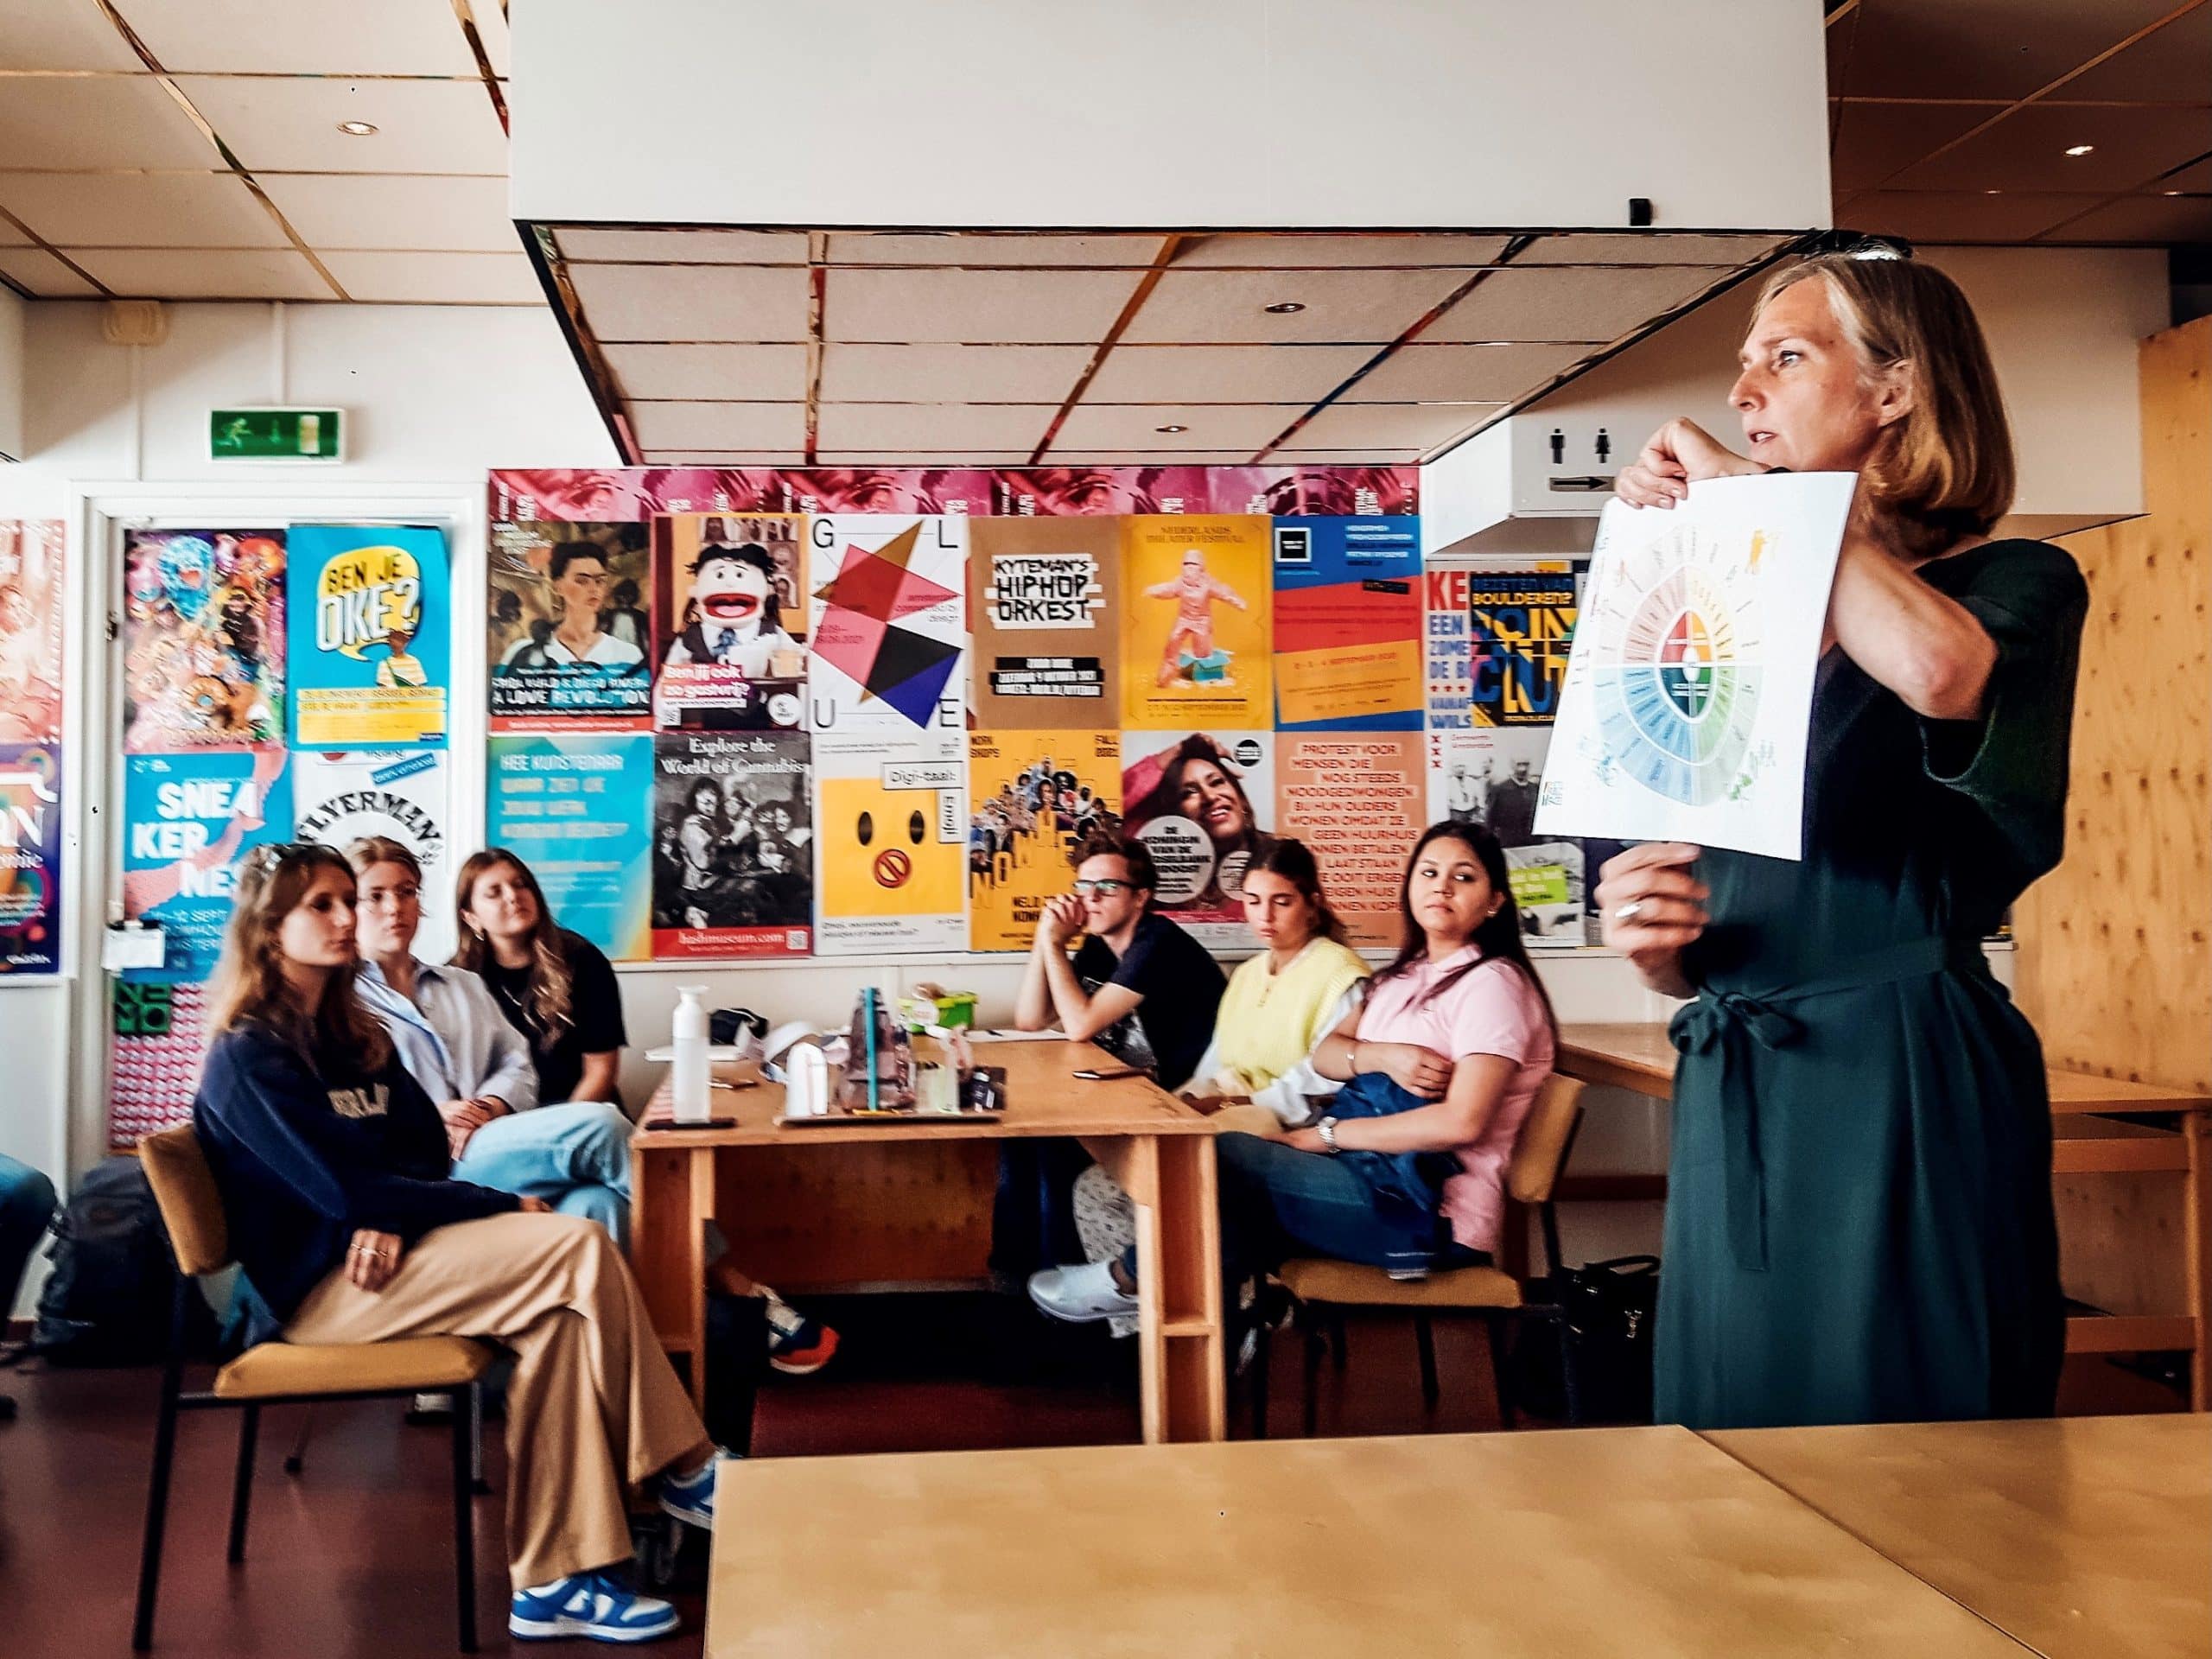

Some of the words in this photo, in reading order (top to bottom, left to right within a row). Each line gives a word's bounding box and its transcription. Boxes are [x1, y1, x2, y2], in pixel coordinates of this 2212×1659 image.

[813, 518, 836, 549] G
[938, 518, 959, 548] L
[327, 562, 367, 592] BEN
[378, 553, 404, 582] JE
[996, 575, 1088, 599] HIPHOP
[316, 576, 420, 651] OKE?
[997, 600, 1090, 622] ORKEST
[1429, 614, 1463, 636] EEN
[710, 664, 742, 679] ook
[492, 690, 505, 704] A
[505, 690, 550, 704] LOVE
[814, 698, 836, 728] U
[939, 698, 960, 728] E
[689, 736, 748, 758] Explore
[749, 736, 776, 753] the
[1302, 745, 1361, 754] PROTEST
[1363, 745, 1396, 754] VOOR
[660, 758, 711, 774] World
[711, 758, 732, 773] of
[732, 757, 804, 774] Cannabis
[1293, 759, 1346, 768] MENSEN
[1349, 759, 1371, 768] DIE
[1322, 773, 1351, 783] NOG
[1352, 773, 1401, 783] STEEDS
[156, 778, 258, 819] SNEA
[1287, 787, 1414, 798] NOODGEDWONGEN
[1345, 802, 1397, 811] OUDERS
[132, 822, 209, 859] KER
[1313, 830, 1347, 839] GEEN
[1353, 844, 1408, 854] BETALEN
[1366, 873, 1407, 882] ERGEN
